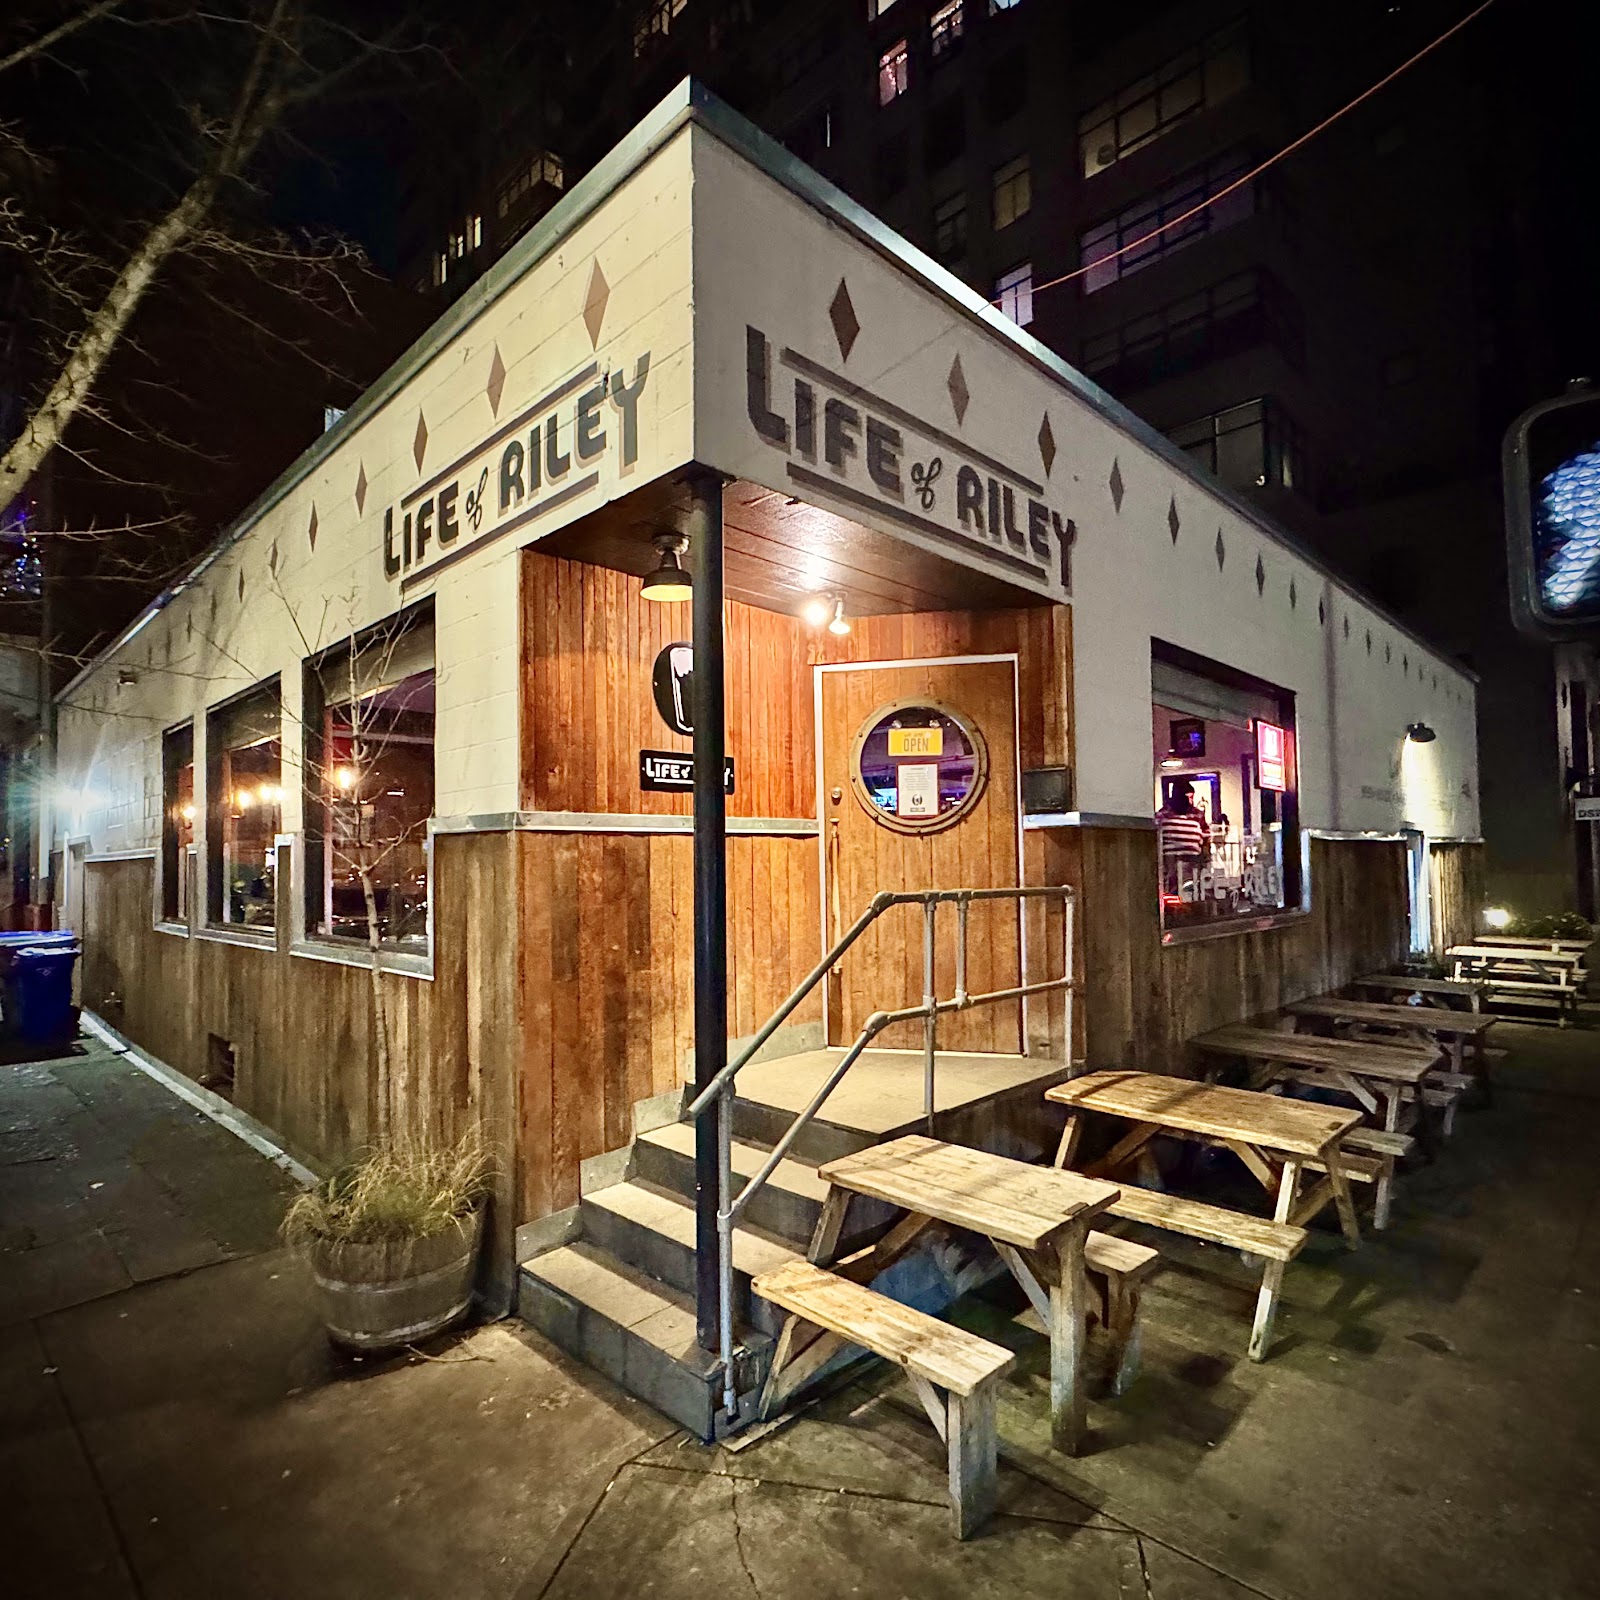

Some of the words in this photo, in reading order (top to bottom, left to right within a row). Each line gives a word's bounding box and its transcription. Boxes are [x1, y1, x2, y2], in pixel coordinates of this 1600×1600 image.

[383, 481, 459, 581] LIFE
[465, 467, 489, 534] of
[497, 350, 651, 519] RILEY
[747, 324, 904, 503] LIFE
[910, 457, 943, 512] of
[956, 464, 1077, 597] RILEY
[645, 757, 681, 779] LIFE
[903, 738, 929, 752] OPEN
